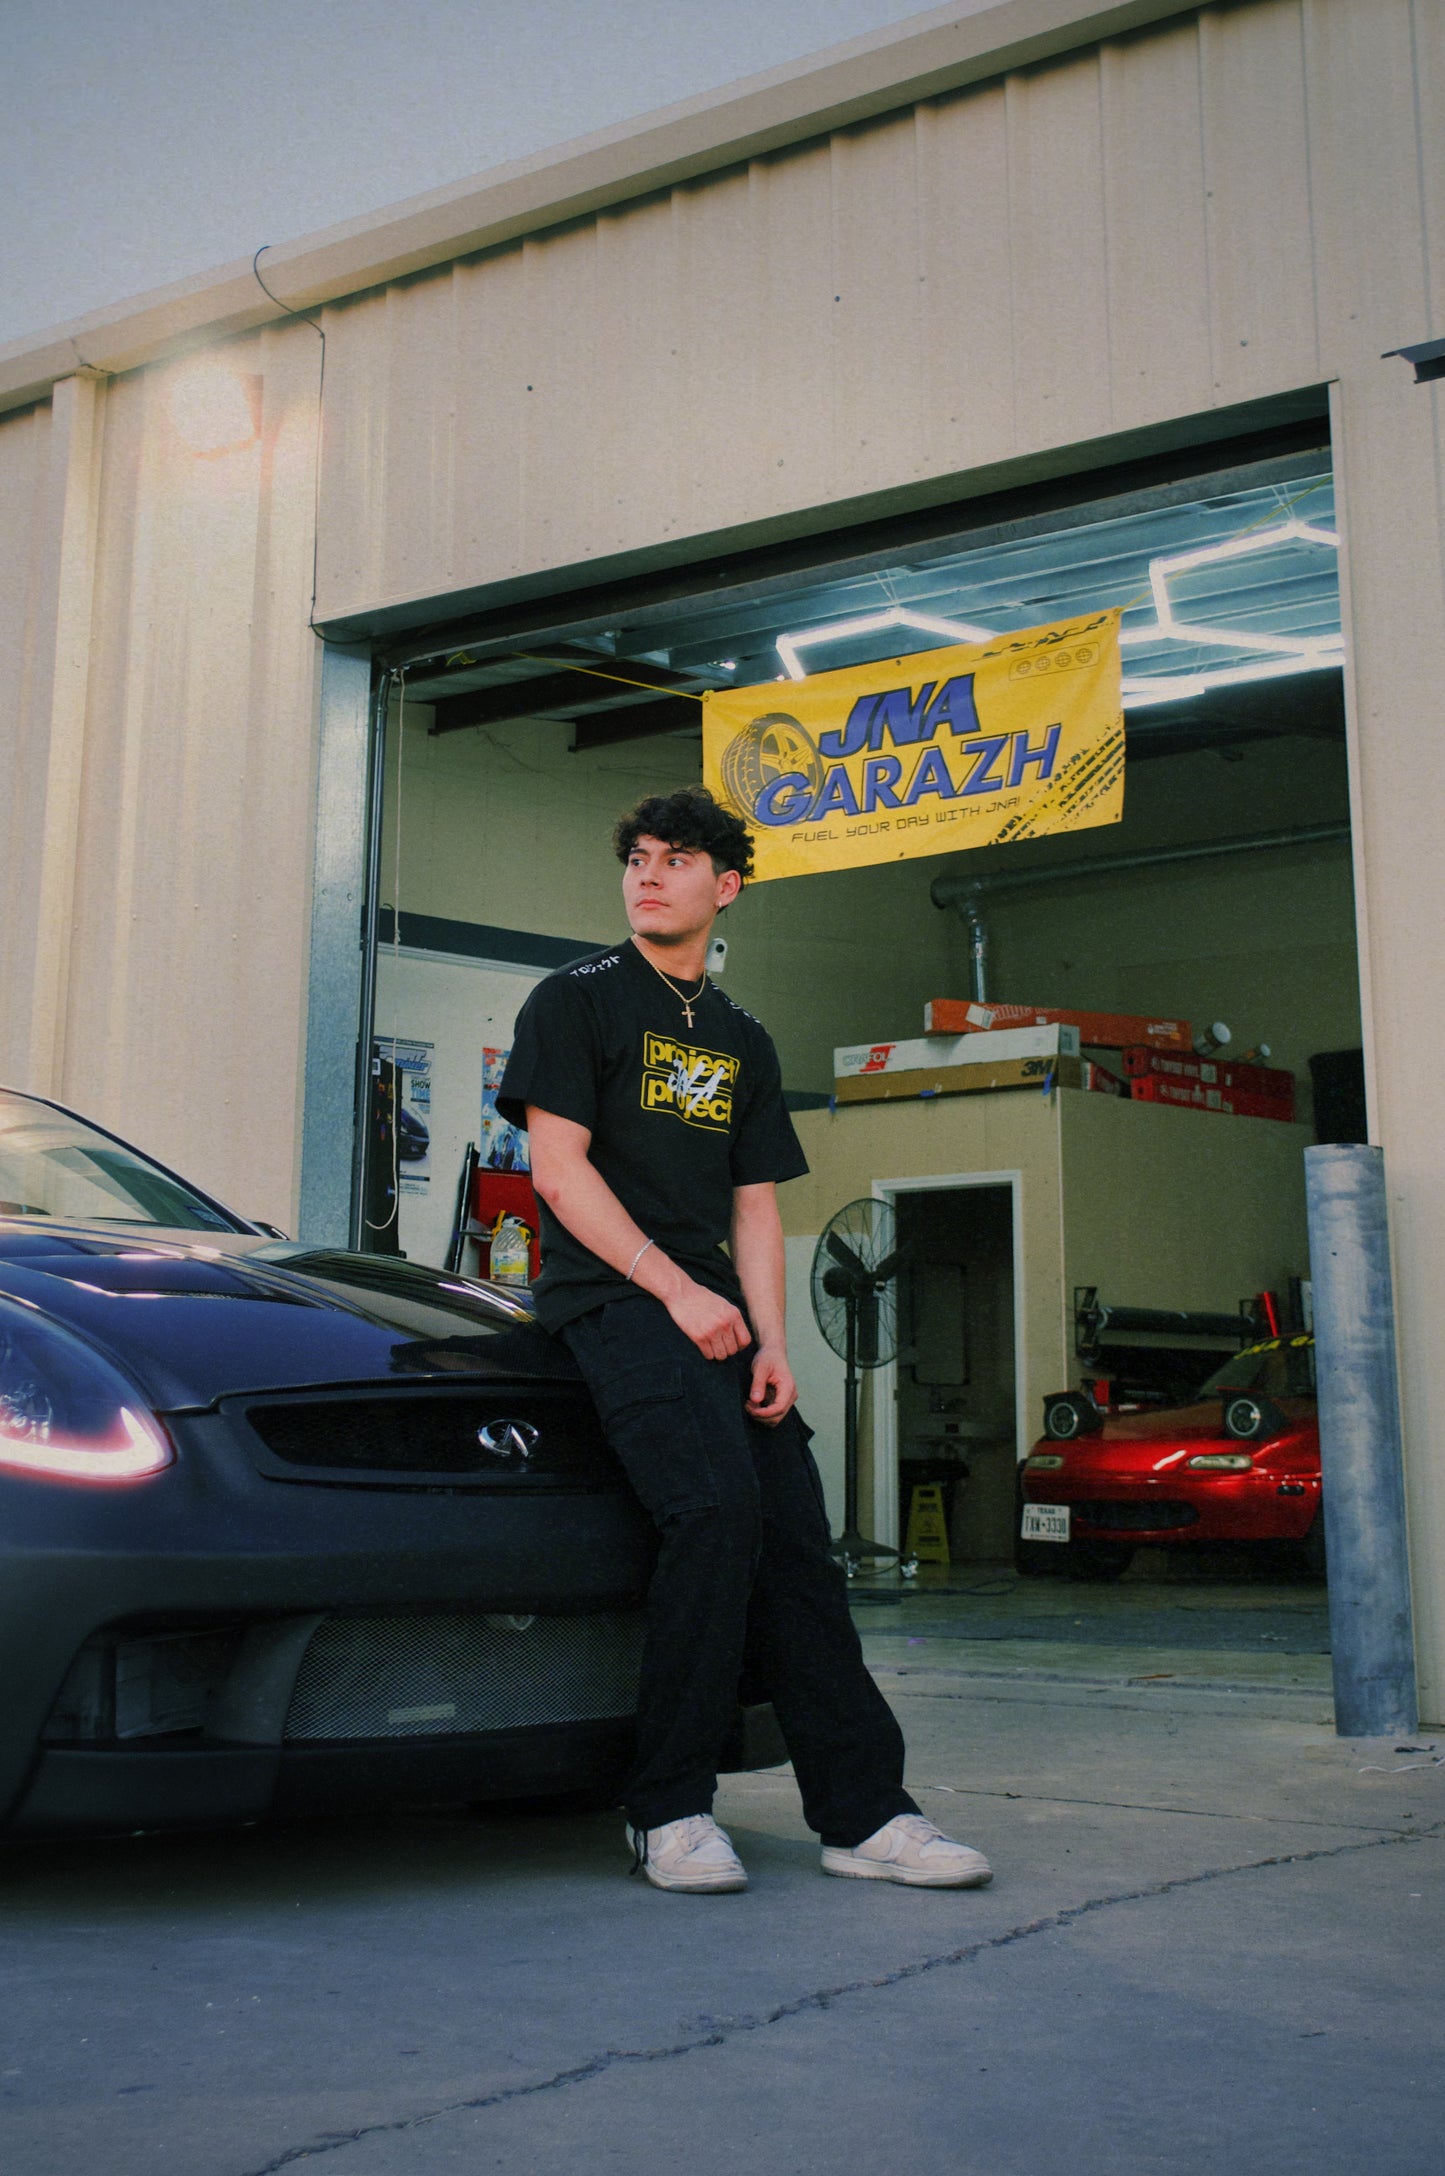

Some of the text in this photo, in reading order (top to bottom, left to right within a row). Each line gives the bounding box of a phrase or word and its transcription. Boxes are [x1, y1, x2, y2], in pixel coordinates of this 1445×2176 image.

[818, 672, 981, 759] JNA
[753, 722, 1062, 826] GARAZH
[791, 830, 839, 843] FUEL
[845, 821, 890, 837] YOUR
[896, 815, 930, 830] DAY
[935, 805, 981, 823] WITH
[411, 1079, 431, 1089] SHOW
[649, 1039, 735, 1084] project
[1021, 1059, 1054, 1077] 3M
[646, 1079, 732, 1124] project
